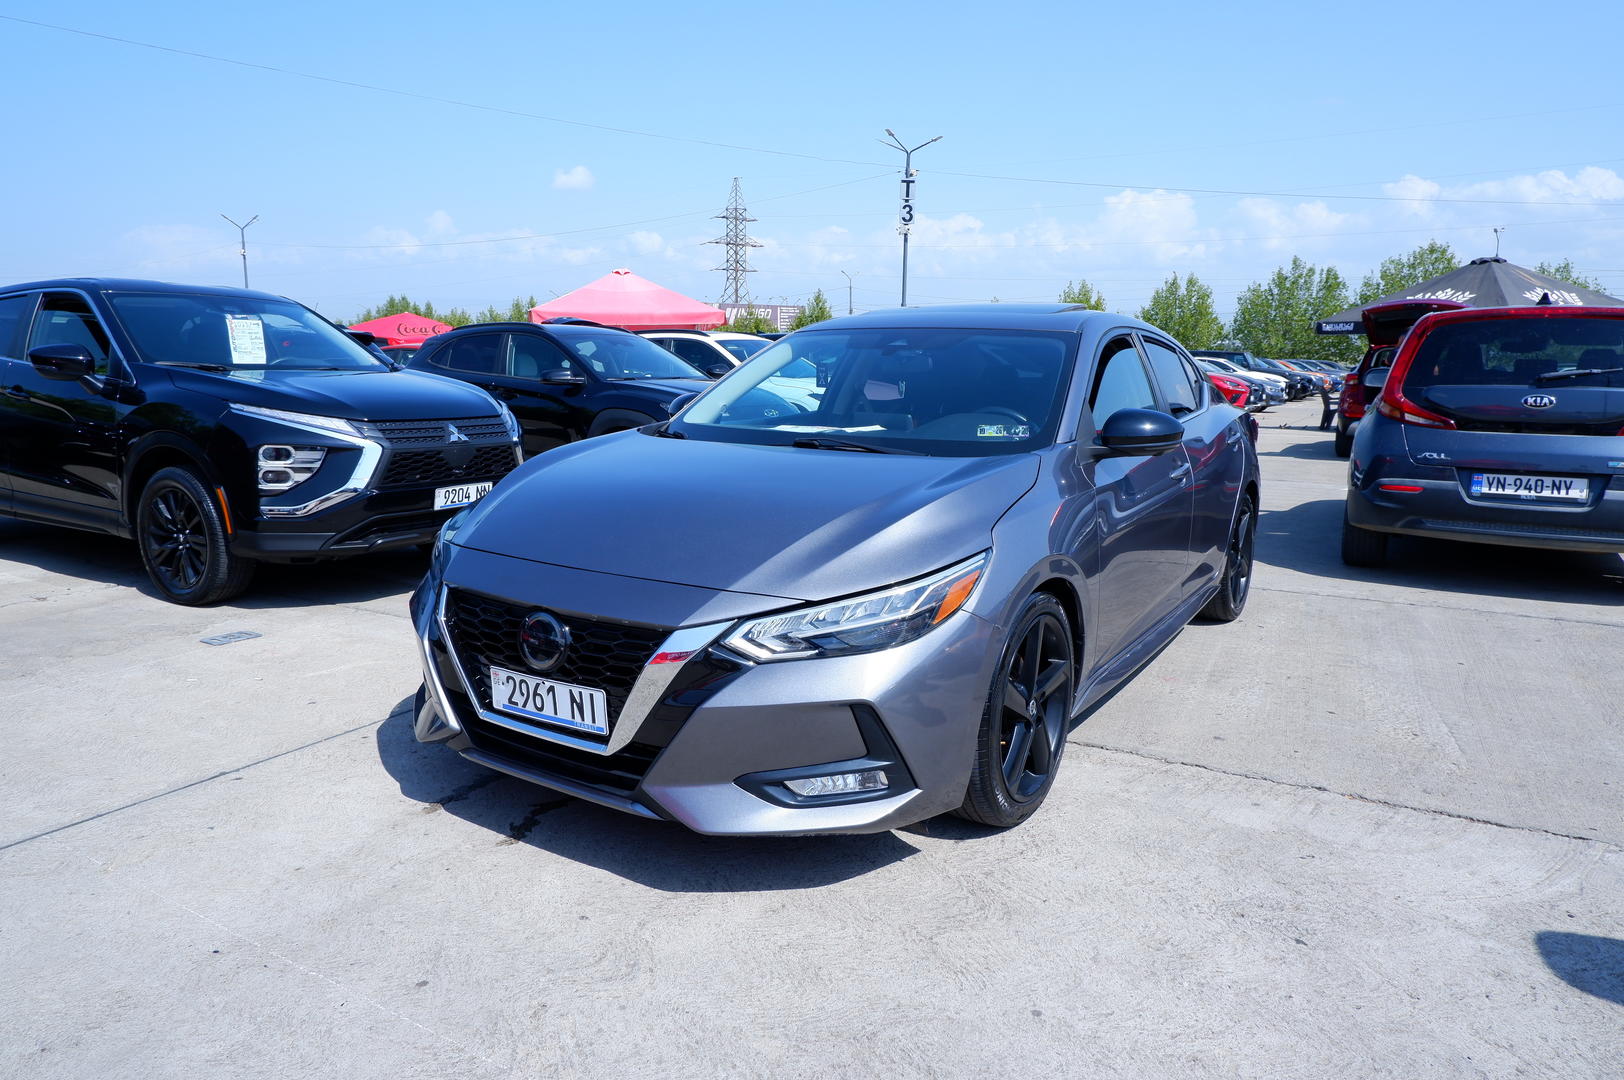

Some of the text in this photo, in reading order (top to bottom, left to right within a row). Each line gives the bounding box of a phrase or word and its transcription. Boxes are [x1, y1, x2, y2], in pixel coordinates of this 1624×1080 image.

[901, 179, 915, 198] T
[901, 204, 914, 223] 3
[397, 323, 430, 336] Coca
[1486, 476, 1573, 496] YN-940-NY
[444, 487, 471, 505] 9204
[506, 675, 597, 725] 2961 NI
